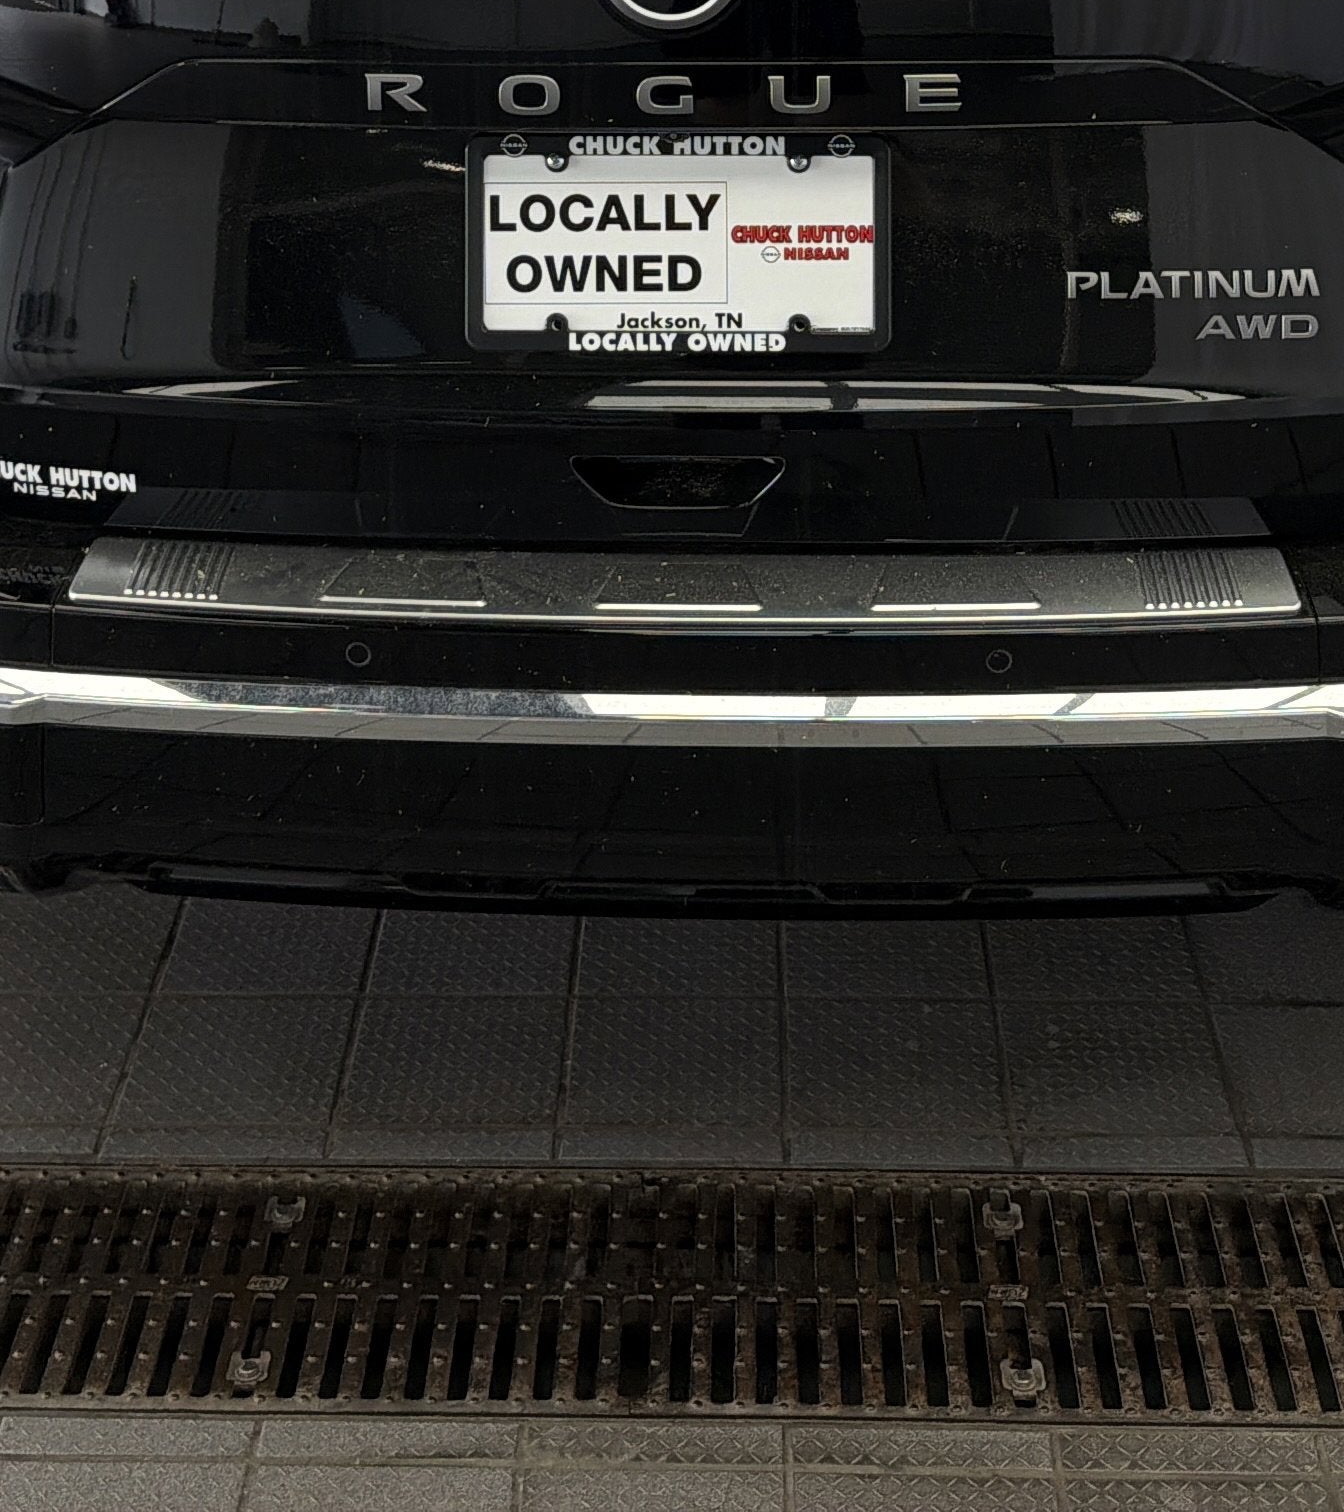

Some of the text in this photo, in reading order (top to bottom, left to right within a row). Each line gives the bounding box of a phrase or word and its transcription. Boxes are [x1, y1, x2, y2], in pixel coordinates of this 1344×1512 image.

[364, 73, 963, 116] ROGUE
[568, 136, 786, 155] CHUCK HUTTON
[489, 194, 721, 233] LOCALLY
[731, 225, 874, 243] CHUCK HUTTON
[783, 247, 849, 260] NISSAN
[506, 255, 702, 293] OWNED
[1067, 268, 1321, 299] PLATINUM
[616, 311, 743, 332] Jackson, TN
[1195, 314, 1319, 339] AWD
[568, 332, 787, 352] LOCALLY OWNED
[49, 466, 137, 493] HUTTON
[13, 481, 97, 502] NISSAN
